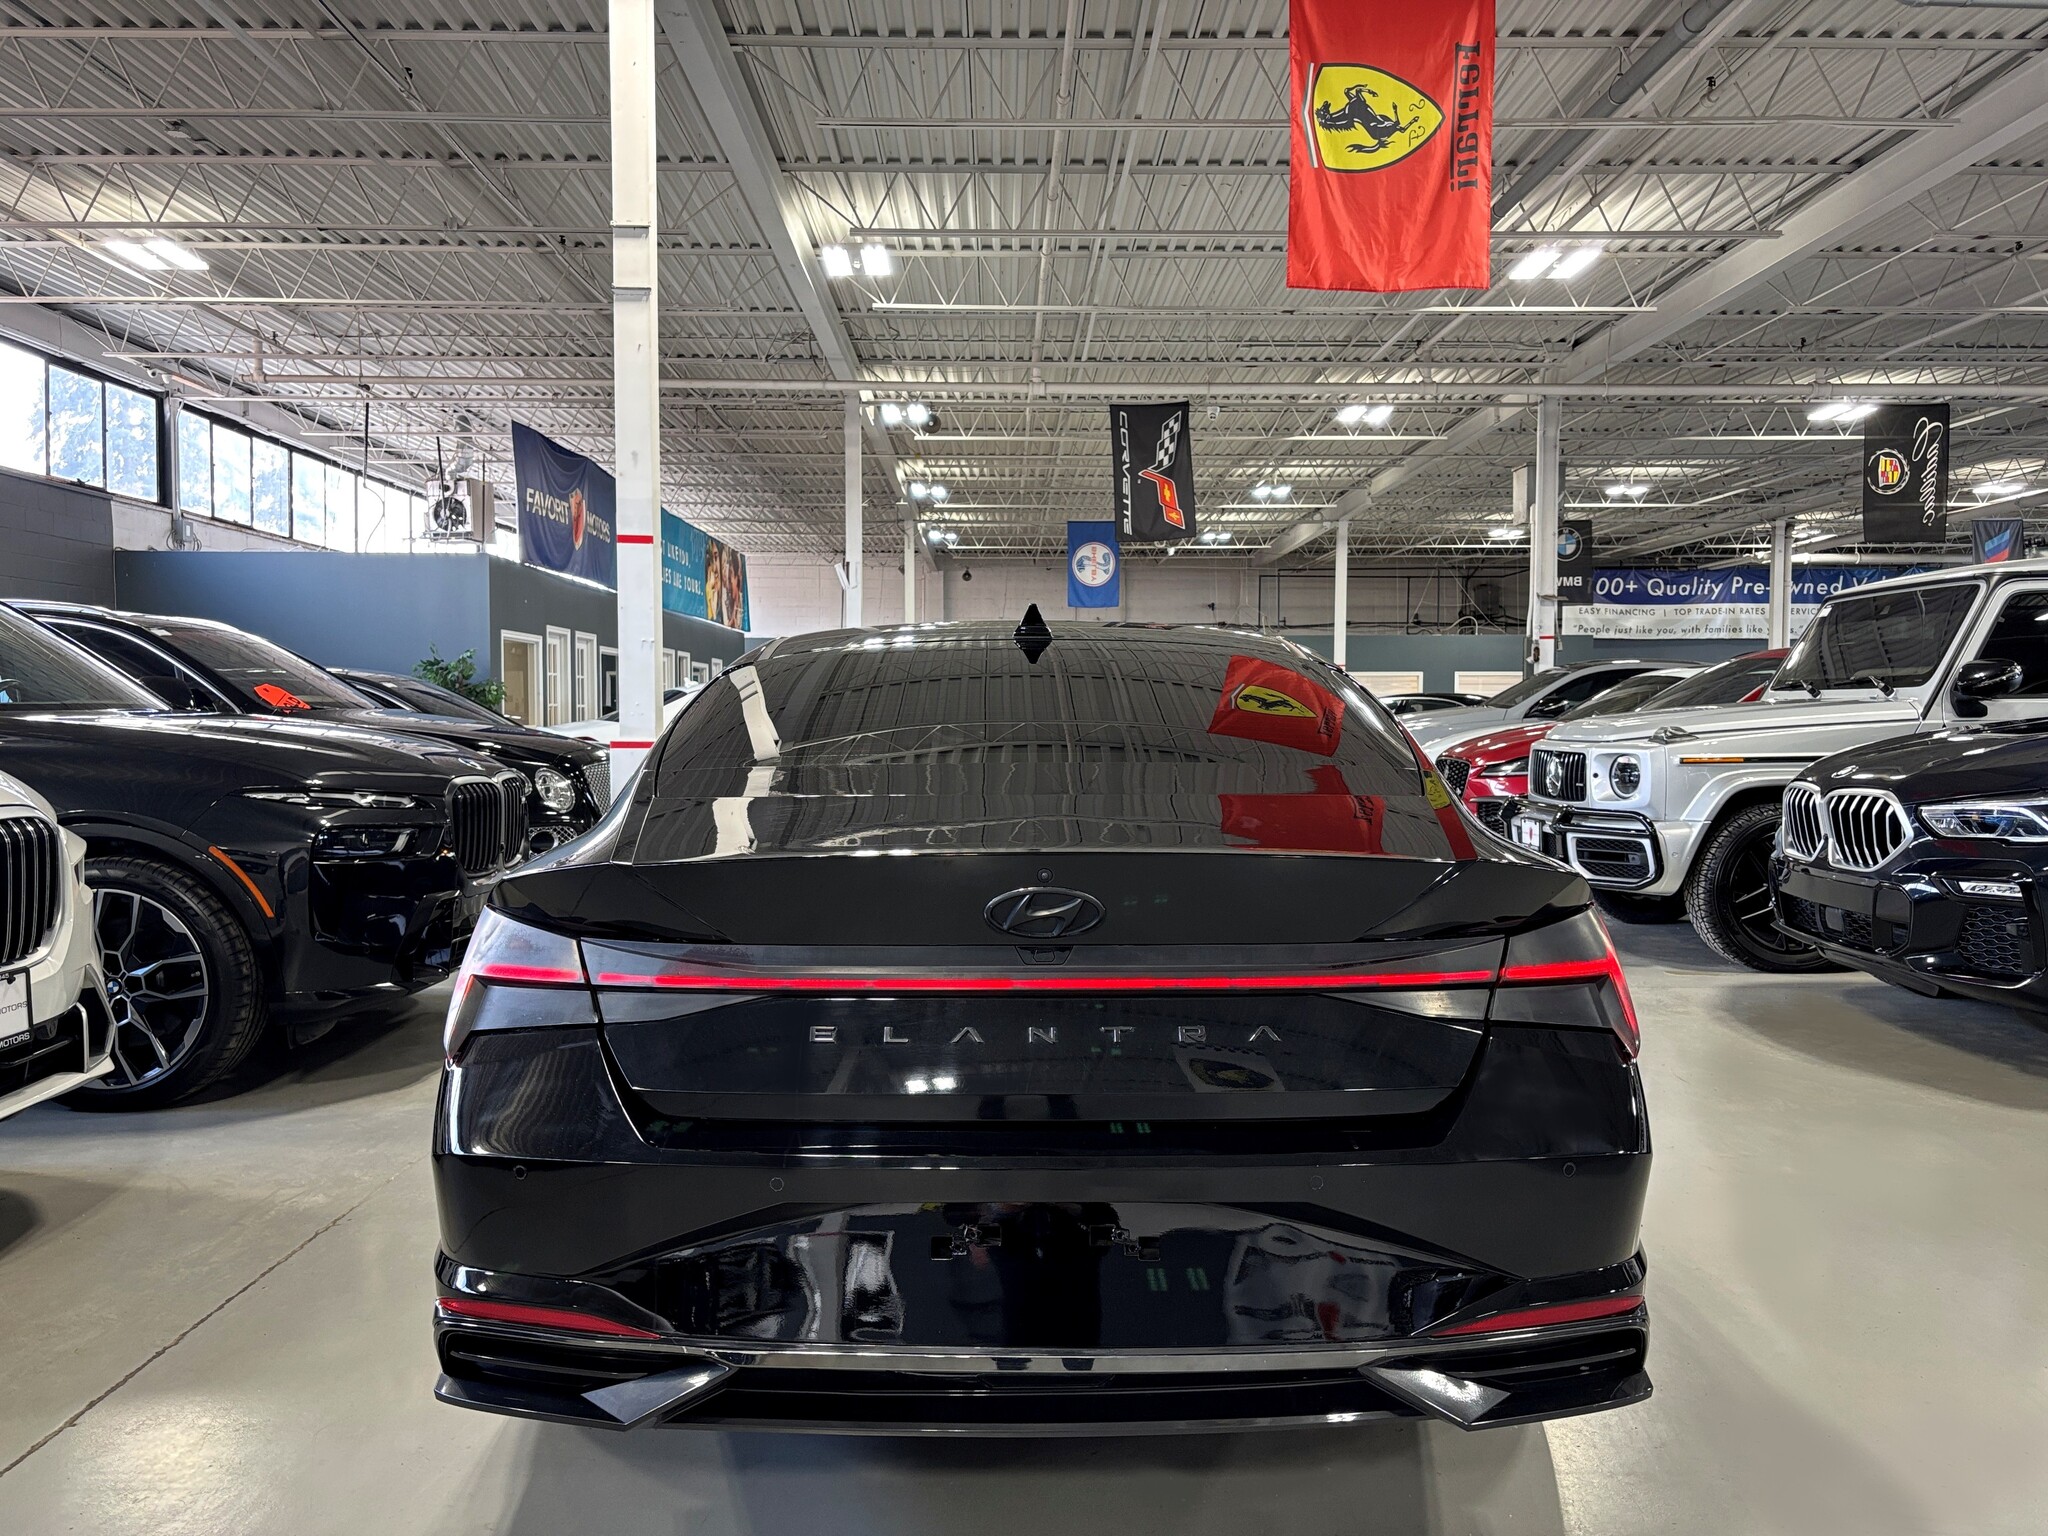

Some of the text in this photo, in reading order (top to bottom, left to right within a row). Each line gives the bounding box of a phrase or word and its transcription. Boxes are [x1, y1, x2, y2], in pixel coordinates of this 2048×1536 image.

[1119, 410, 1133, 536] CORVETTE
[526, 487, 611, 544] FAVORIT MOTORS
[1647, 576, 1724, 601] Quality
[1578, 607, 1601, 616] EASY
[1604, 608, 1656, 617] FINANCING
[1674, 607, 1692, 616] TOP
[1695, 607, 1736, 616] TRADE-IN
[1739, 607, 1766, 616] RATES
[1614, 624, 1632, 636] just
[1635, 624, 1653, 635] like
[1656, 626, 1677, 637] you,
[1681, 623, 1701, 635] with
[1704, 623, 1742, 635] families
[1746, 623, 1763, 635] like
[0, 1000, 28, 1015] OTORS
[809, 1025, 1283, 1045] ELANTRA
